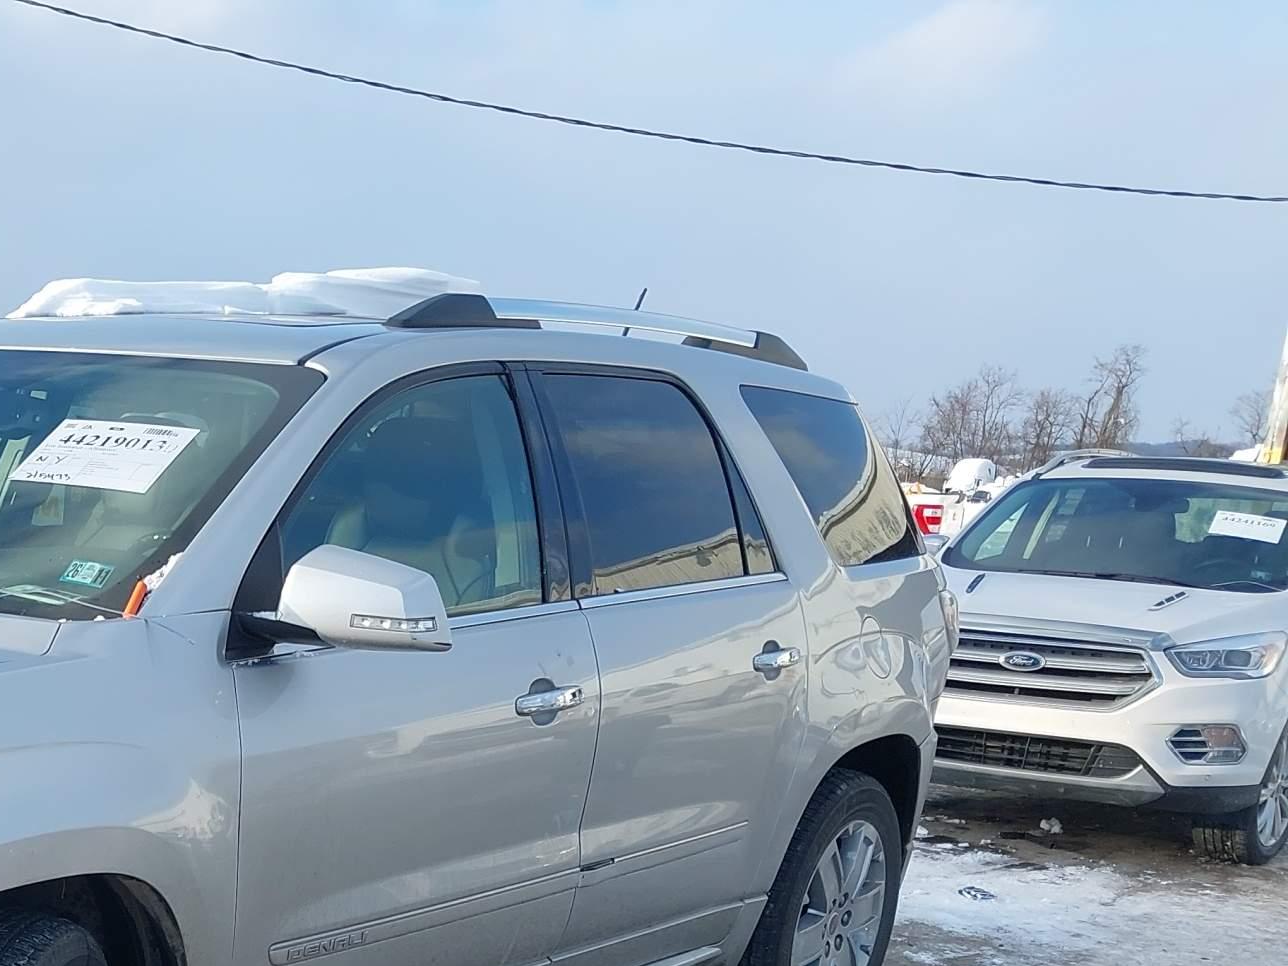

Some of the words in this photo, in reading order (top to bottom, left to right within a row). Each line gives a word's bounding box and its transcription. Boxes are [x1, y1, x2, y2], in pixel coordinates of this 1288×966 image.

[58, 434, 167, 450] 44219013
[1008, 655, 1035, 666] Ford
[286, 930, 369, 961] DENALI
